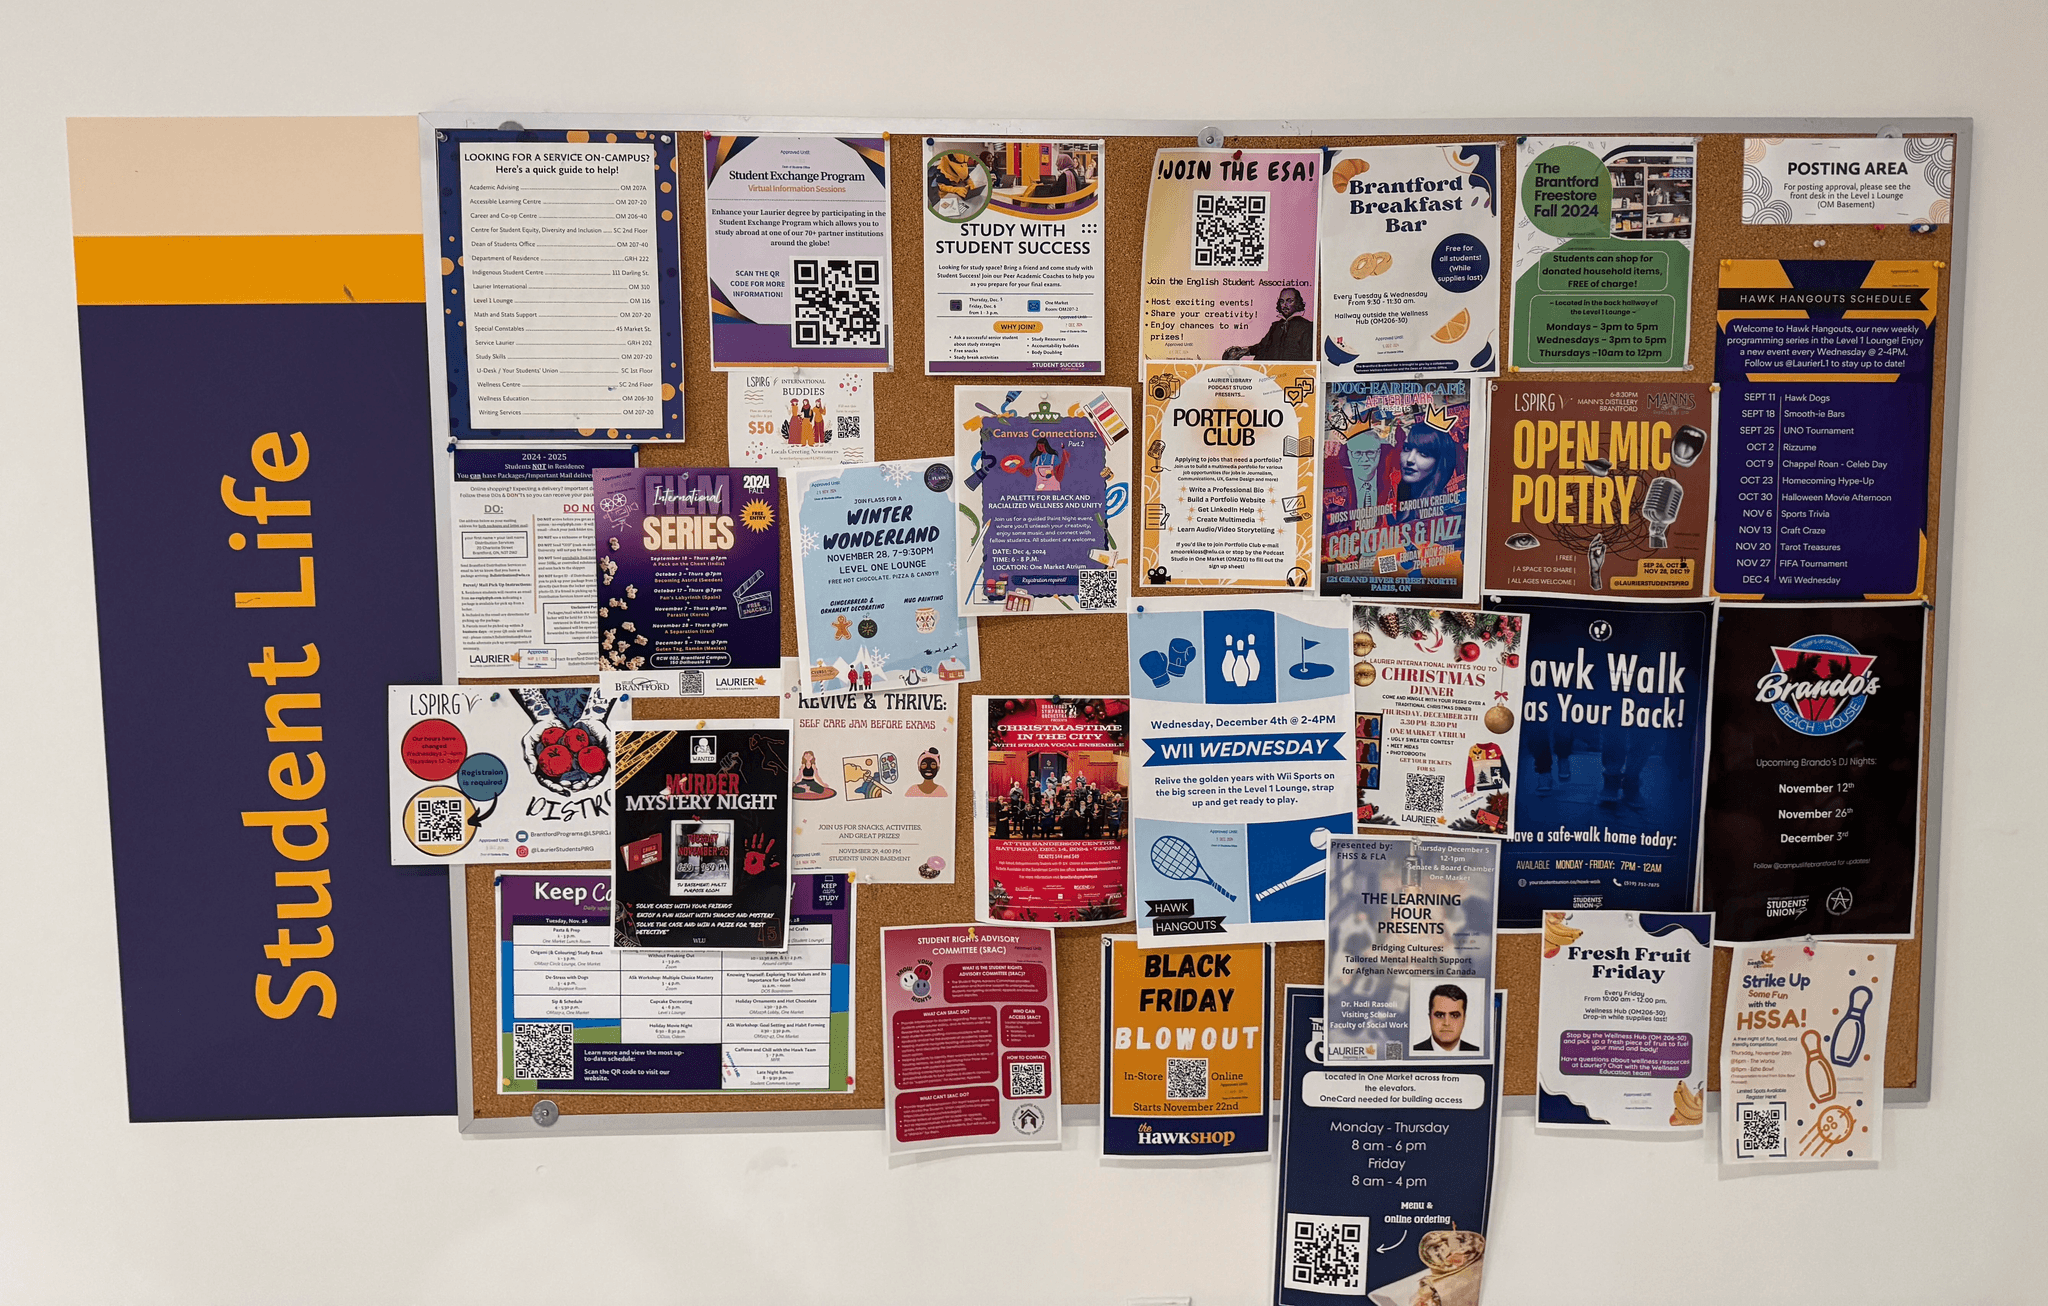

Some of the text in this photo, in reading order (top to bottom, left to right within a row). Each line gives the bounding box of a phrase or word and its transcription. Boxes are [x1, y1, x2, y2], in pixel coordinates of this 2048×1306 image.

[585, 154, 650, 162] ON-CAMPUS?
[496, 165, 522, 173] Here's
[533, 166, 556, 175] quick
[559, 166, 582, 175] guide
[598, 166, 618, 176] help!
[1220, 158, 1258, 181] THE
[1268, 161, 1314, 182] ESA!
[1536, 163, 1560, 173] The
[1788, 162, 1908, 175] POSTING AREA
[730, 170, 865, 183] Student Exchange Program
[1536, 176, 1598, 187] Brantford
[1350, 176, 1462, 194] Brantford
[1535, 190, 1596, 200] Freestore
[1350, 197, 1462, 214] Breakfast
[1534, 204, 1598, 217] Fall 2024
[959, 222, 1064, 236] STUDY WITH
[1386, 218, 1427, 232] Bar
[936, 241, 1090, 254] STUDENT SUCCESS
[1187, 278, 1219, 287] English
[1223, 278, 1255, 286] Student
[1259, 279, 1312, 288] Association.
[1780, 295, 1845, 303] HANGOUTS
[1851, 295, 1911, 303] SCHEDULE
[1547, 323, 1590, 333] Mondays
[1600, 323, 1622, 332] 3pm
[1637, 323, 1658, 332] 5pm
[1515, 393, 1555, 412] LSPIRG
[1174, 409, 1283, 429] PORTFOLIO
[749, 421, 774, 434] $50
[991, 428, 1099, 438] Canvas Connections:
[1204, 428, 1255, 446] CLUB
[1514, 420, 1671, 470] OPEN MIC
[744, 476, 770, 490] 2024
[1512, 473, 1637, 524] POETRY
[848, 505, 913, 525] WINTER
[643, 516, 734, 550] SERIES
[824, 528, 939, 551] WONDERLAND
[1329, 517, 1463, 559] COCKTAILS & JAZZ
[827, 552, 874, 562] NOVEMBER
[893, 547, 933, 558] 7-9:30PM
[839, 559, 926, 574] LEVEL ONE LOUNGE
[1794, 576, 1840, 585] Wednesday
[1397, 660, 1444, 669] INTERNATIONAL
[1446, 662, 1469, 670] INVITES
[1523, 648, 1685, 693] awk Walk
[716, 678, 754, 686] LAURIER
[1382, 668, 1486, 688] CHRISTMAS
[1408, 686, 1453, 698] DINNER
[1756, 670, 1880, 704] Brando's
[411, 694, 460, 715] LSPIRG
[886, 694, 946, 710] THRIVE:
[1522, 692, 1684, 728] as Your Back!
[1779, 701, 1861, 733] BEACH HOUSE
[220, 430, 338, 1021] Student Life
[800, 719, 935, 729] SELF CARE JAM BEFORE EXAMS
[1160, 738, 1330, 760] WII WEDNESDAY
[471, 778, 503, 787] required
[1779, 784, 1833, 793] November
[626, 792, 777, 811] MYSTERY NIGHT
[536, 882, 587, 902] Keep
[1361, 892, 1461, 906] THE LEARNING
[1391, 908, 1431, 919] HOUR
[1378, 922, 1444, 934] PRESENTS
[918, 936, 950, 944] STUDENT
[932, 946, 1006, 955] COMMITTEE (SRAC)
[1568, 947, 1690, 962] Fresh Fruit
[1145, 954, 1231, 977] BLACK
[1592, 964, 1665, 984] Friday
[1743, 974, 1810, 991] Strike Up
[1140, 989, 1234, 1012] FRIDAY
[1737, 1009, 1806, 1030] HSSA!
[1115, 1026, 1258, 1050] BLOWOUT
[1134, 1102, 1238, 1112] Starts November 22nd
[1138, 1123, 1152, 1133] the
[1330, 1122, 1384, 1135] Monday
[1395, 1122, 1449, 1135] Thursday
[1368, 1158, 1406, 1171] Friday
